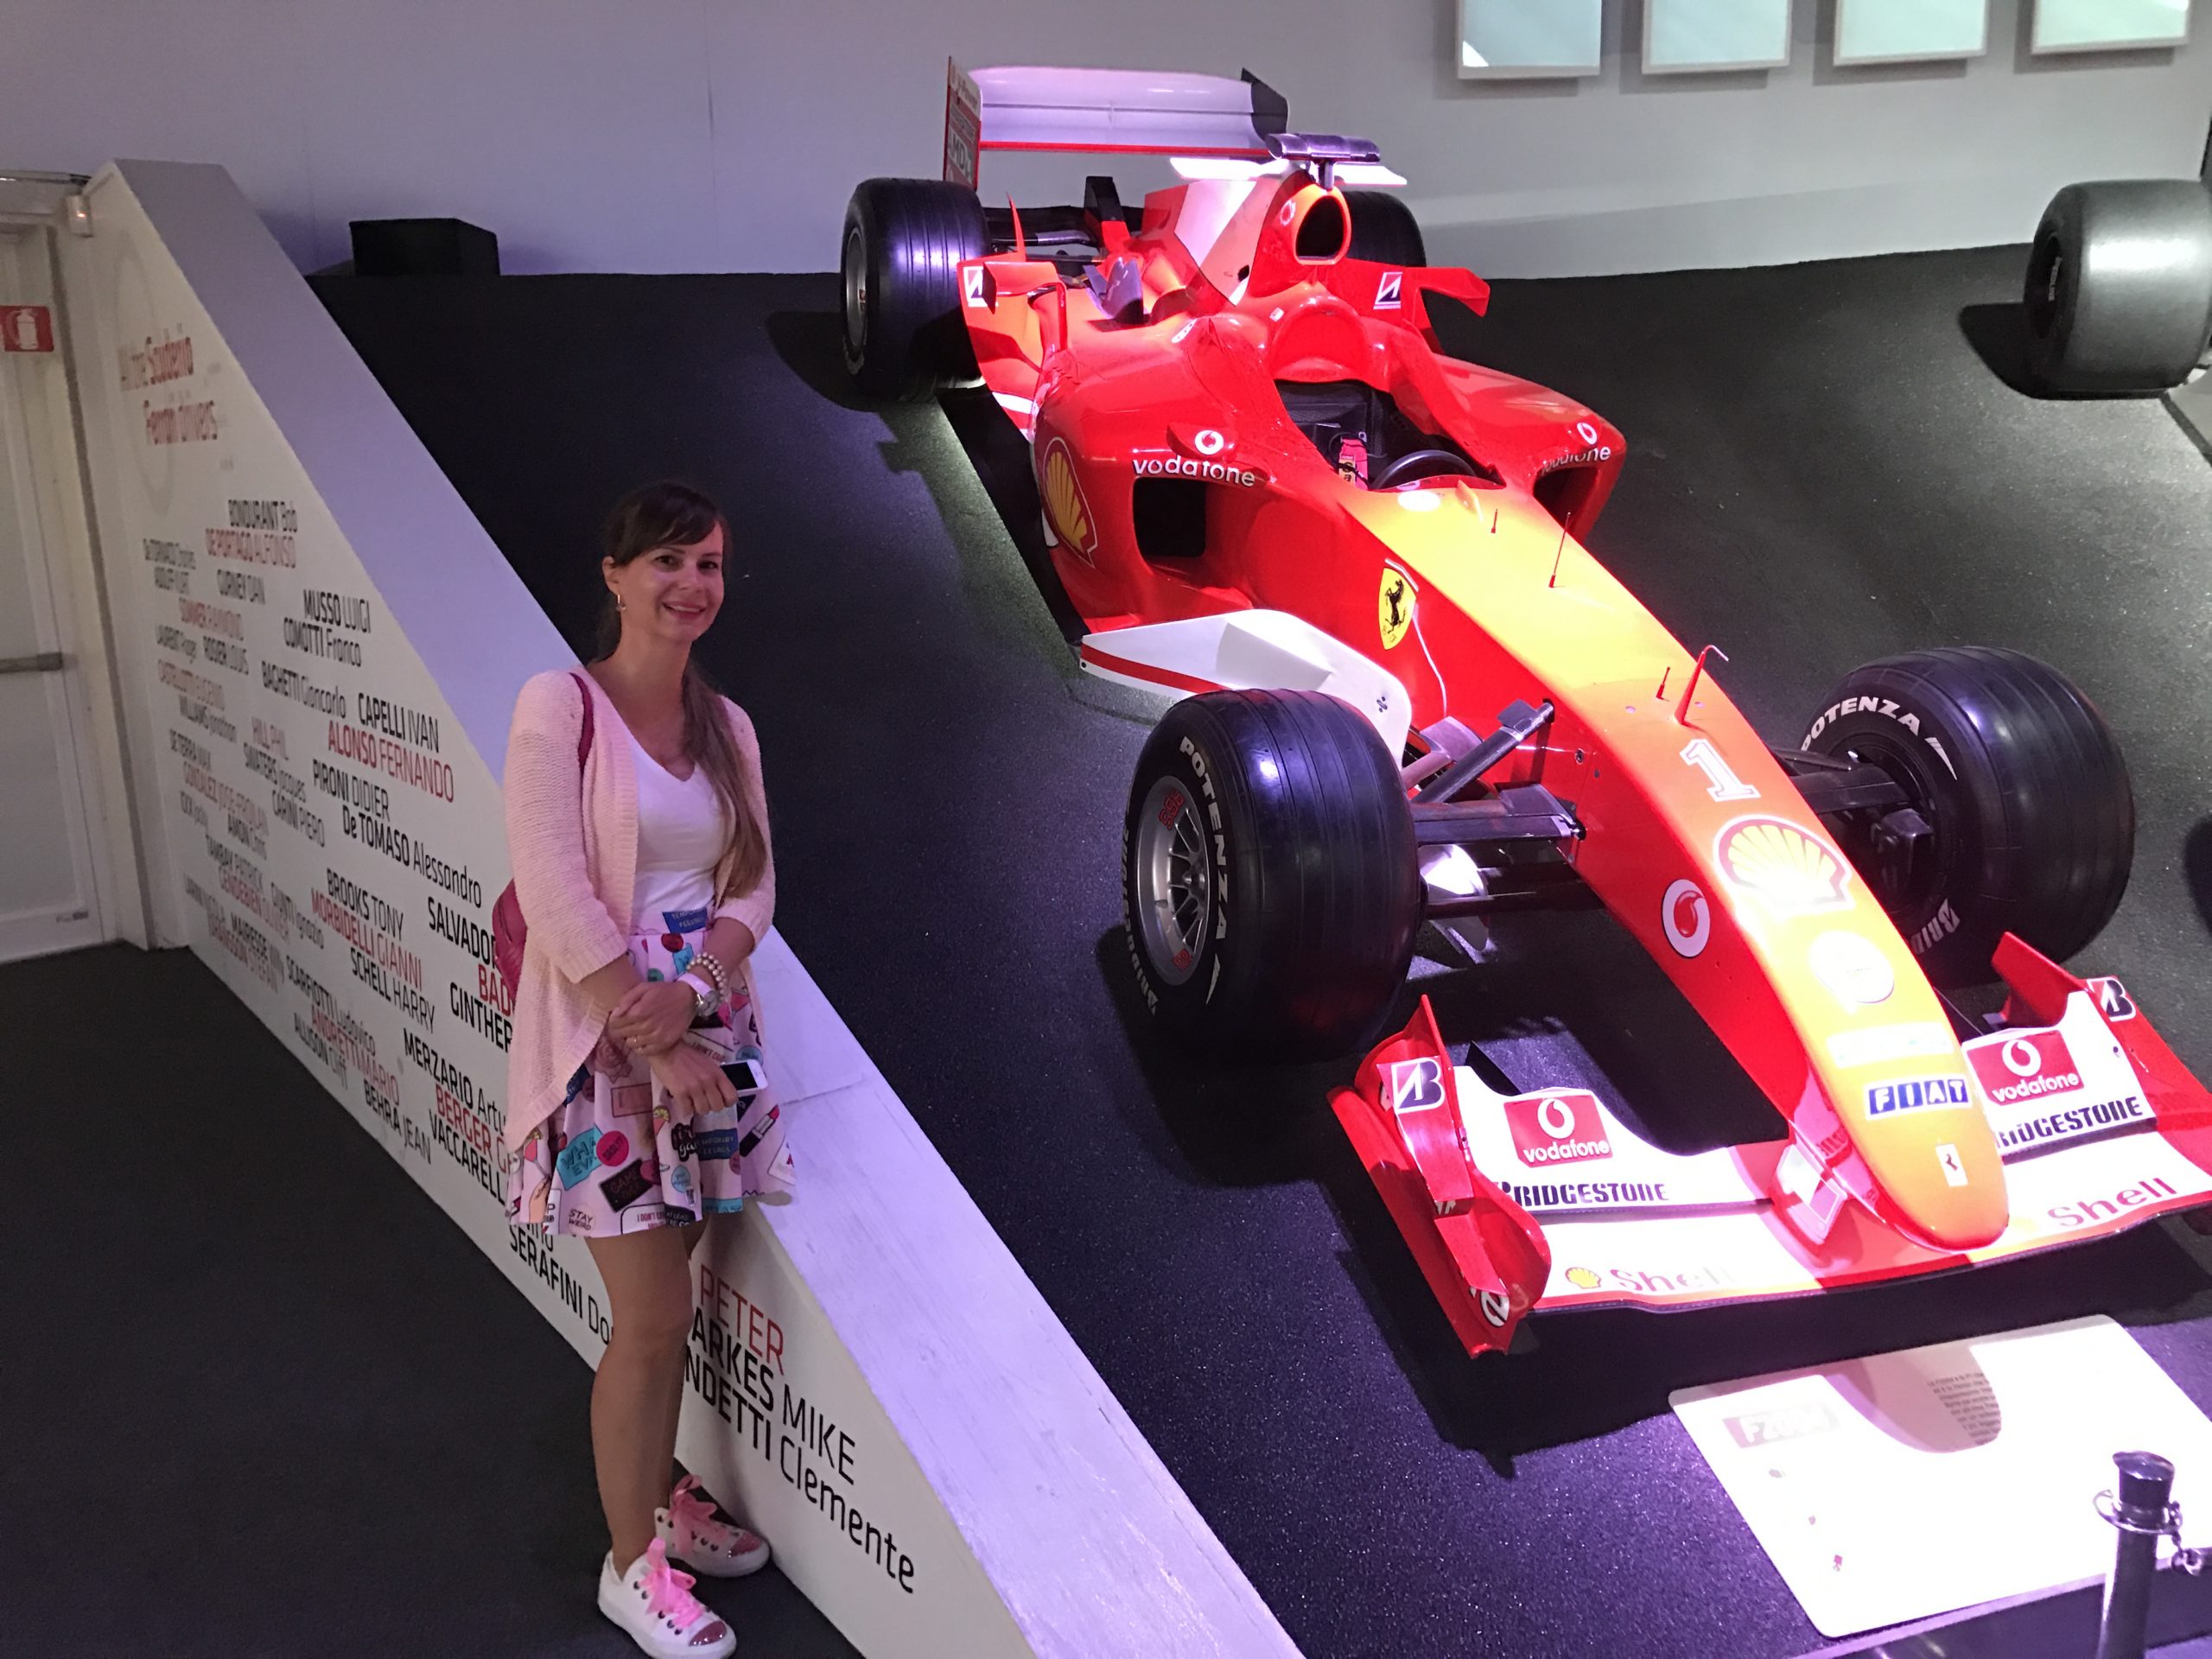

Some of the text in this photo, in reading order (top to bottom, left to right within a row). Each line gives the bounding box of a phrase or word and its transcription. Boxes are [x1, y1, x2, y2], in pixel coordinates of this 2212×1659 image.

[1133, 455, 1255, 487] vodafone
[283, 617, 361, 667] COMOTTI Franco
[303, 589, 371, 633] MUSSO LUIGI
[262, 660, 346, 719] BAGHETTI Giancarlo
[359, 693, 439, 753] CAPELLI IVAN
[1801, 696, 1920, 751] POTENZA
[313, 759, 390, 822] PIRONI DIDIER
[328, 721, 454, 803] ALONSO FERNANDO
[1679, 739, 1762, 802] 1
[342, 804, 482, 909] De TOMASO Alessandro
[1180, 736, 1228, 939] POTENZA
[327, 868, 404, 943] BROOKS TONY
[311, 887, 423, 994] MORBIDELLI GIANNI
[350, 947, 435, 1034] SCHELL HARRY
[478, 963, 514, 1018] BAD
[311, 1004, 400, 1106] ANDRETTI MARIO
[404, 1027, 506, 1136] MERZARIO Artu
[1868, 1078, 1969, 1115] FIAT
[1992, 1072, 2079, 1103] vodafone
[363, 1078, 402, 1136] BEHRA
[403, 1115, 432, 1166] JEAN
[435, 1084, 493, 1161] BERGER
[1523, 1139, 1611, 1165] vodafone
[1997, 1096, 2143, 1148] RIDGESTONE
[429, 1109, 505, 1206] VACCARELL
[569, 1208, 594, 1224] STAY
[569, 1217, 592, 1230] WEIRD
[2047, 1178, 2177, 1228] Shell
[510, 1224, 582, 1319] SERAFINI
[588, 1295, 613, 1345] Do
[700, 1264, 785, 1376] PETER
[691, 1307, 856, 1486] ARKES MIKE
[685, 1344, 915, 1594] NDETTI Clemente
